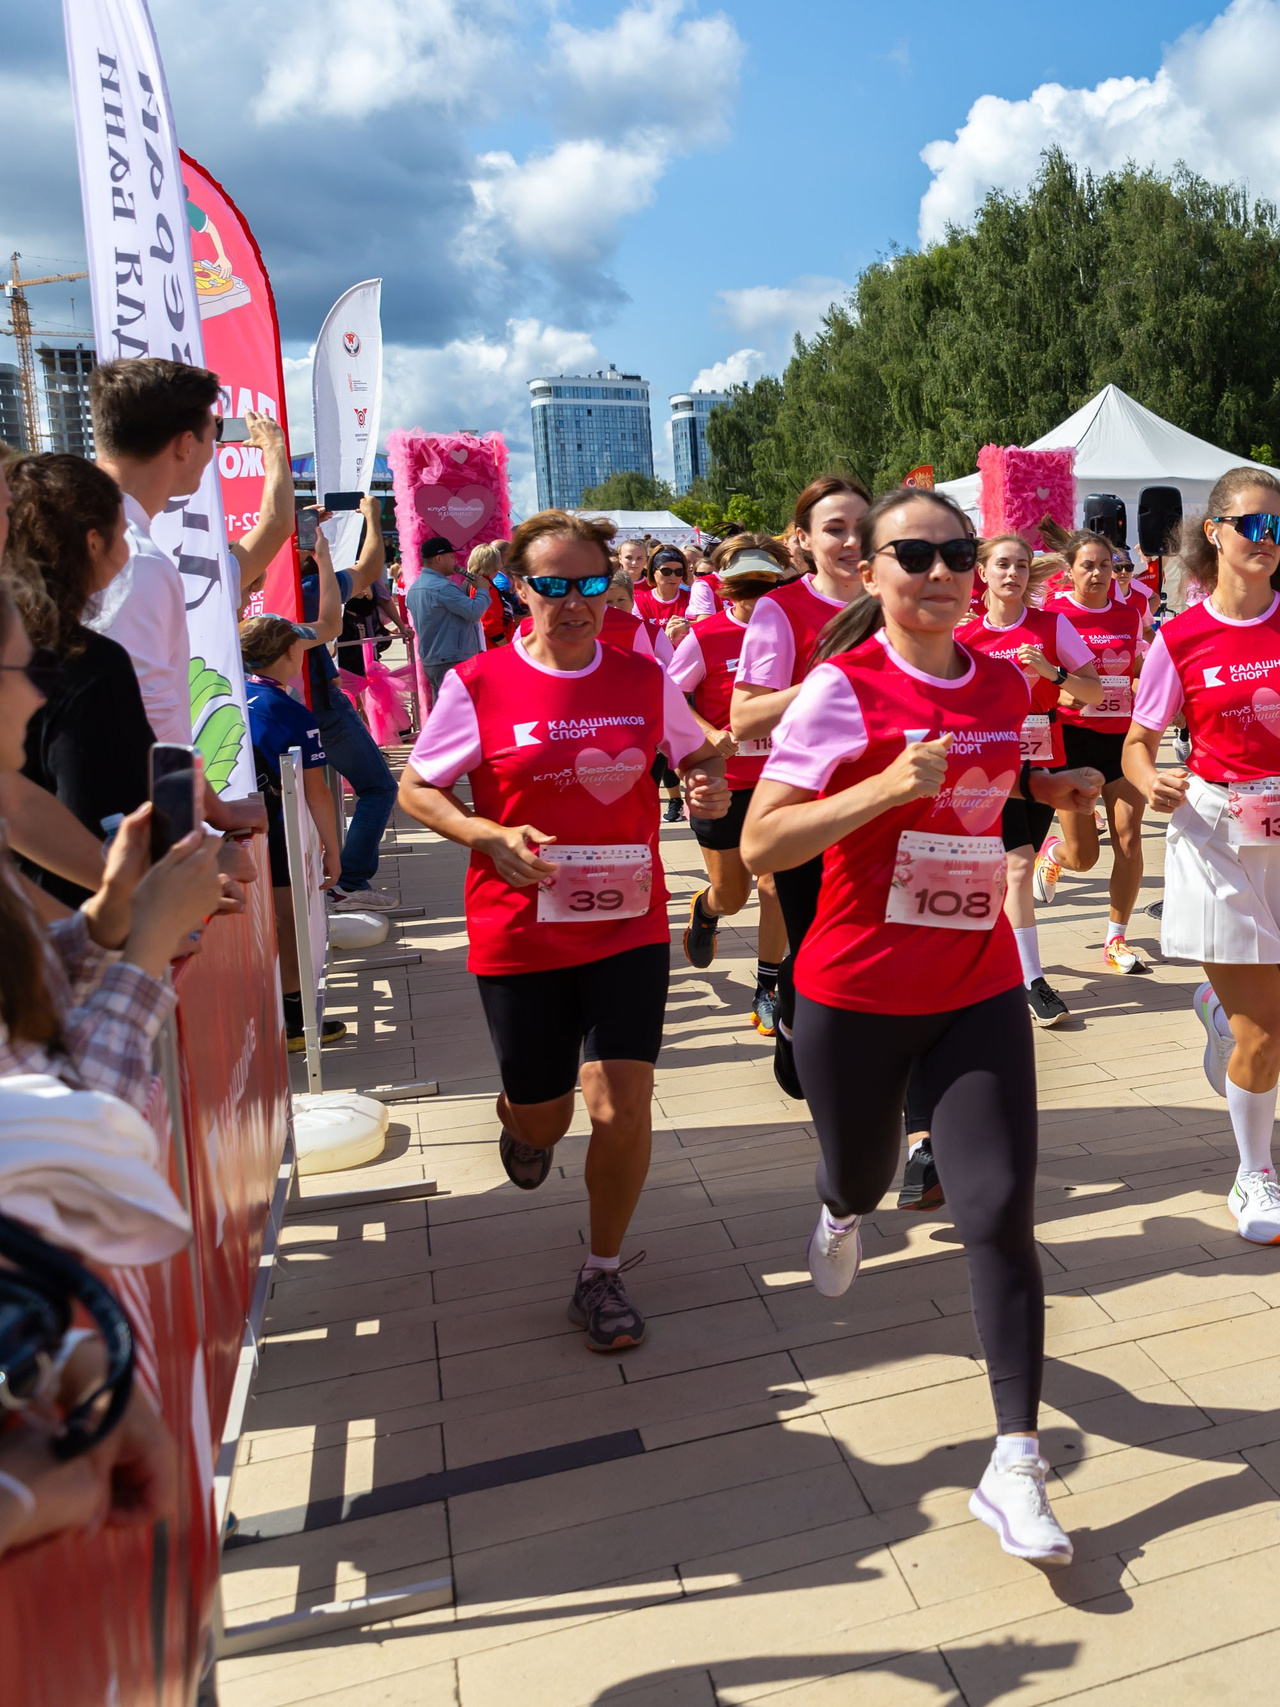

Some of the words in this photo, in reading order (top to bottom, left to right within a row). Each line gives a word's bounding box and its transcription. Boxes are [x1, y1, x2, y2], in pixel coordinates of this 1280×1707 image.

[1231, 669, 1269, 682] СПОРТ
[1221, 705, 1251, 717] клуб
[548, 716, 646, 731] КАЛАШНИКОВ
[549, 727, 598, 741] СПОРТ
[533, 768, 573, 782] клуб
[576, 762, 645, 775] беговых
[555, 773, 625, 793] принцесс
[569, 889, 624, 912] 39
[914, 888, 992, 918] 108
